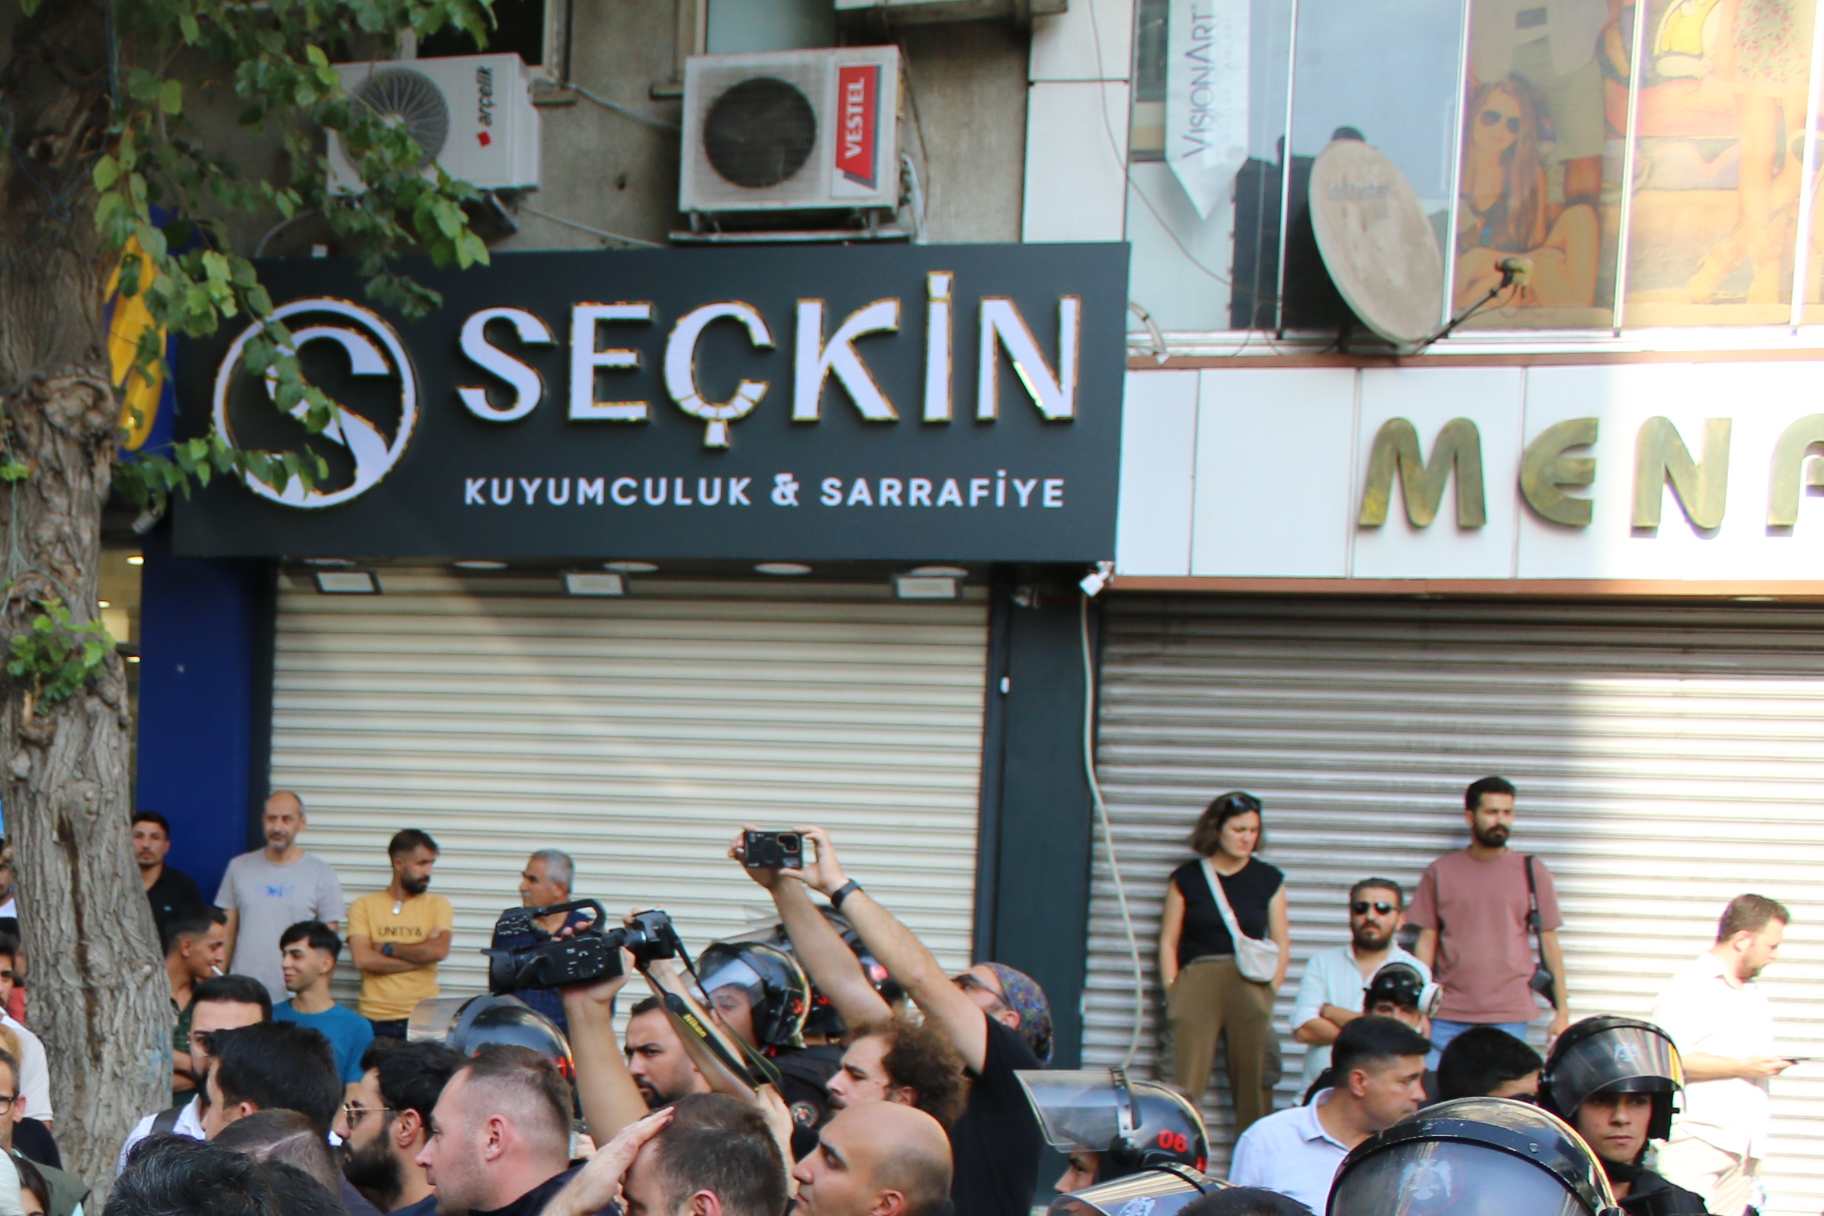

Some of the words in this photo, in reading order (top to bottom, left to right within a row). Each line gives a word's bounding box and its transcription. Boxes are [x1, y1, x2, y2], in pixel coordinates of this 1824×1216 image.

[476, 65, 495, 127] arçelik
[843, 77, 866, 159] VESTEL
[456, 271, 1080, 449] SEÇKİN
[464, 477, 751, 506] KUYUMCULUK
[772, 472, 800, 506] &
[820, 469, 1065, 508] SARRAFİYE
[682, 1013, 708, 1038] Nikon
[1158, 1129, 1189, 1153] 06
